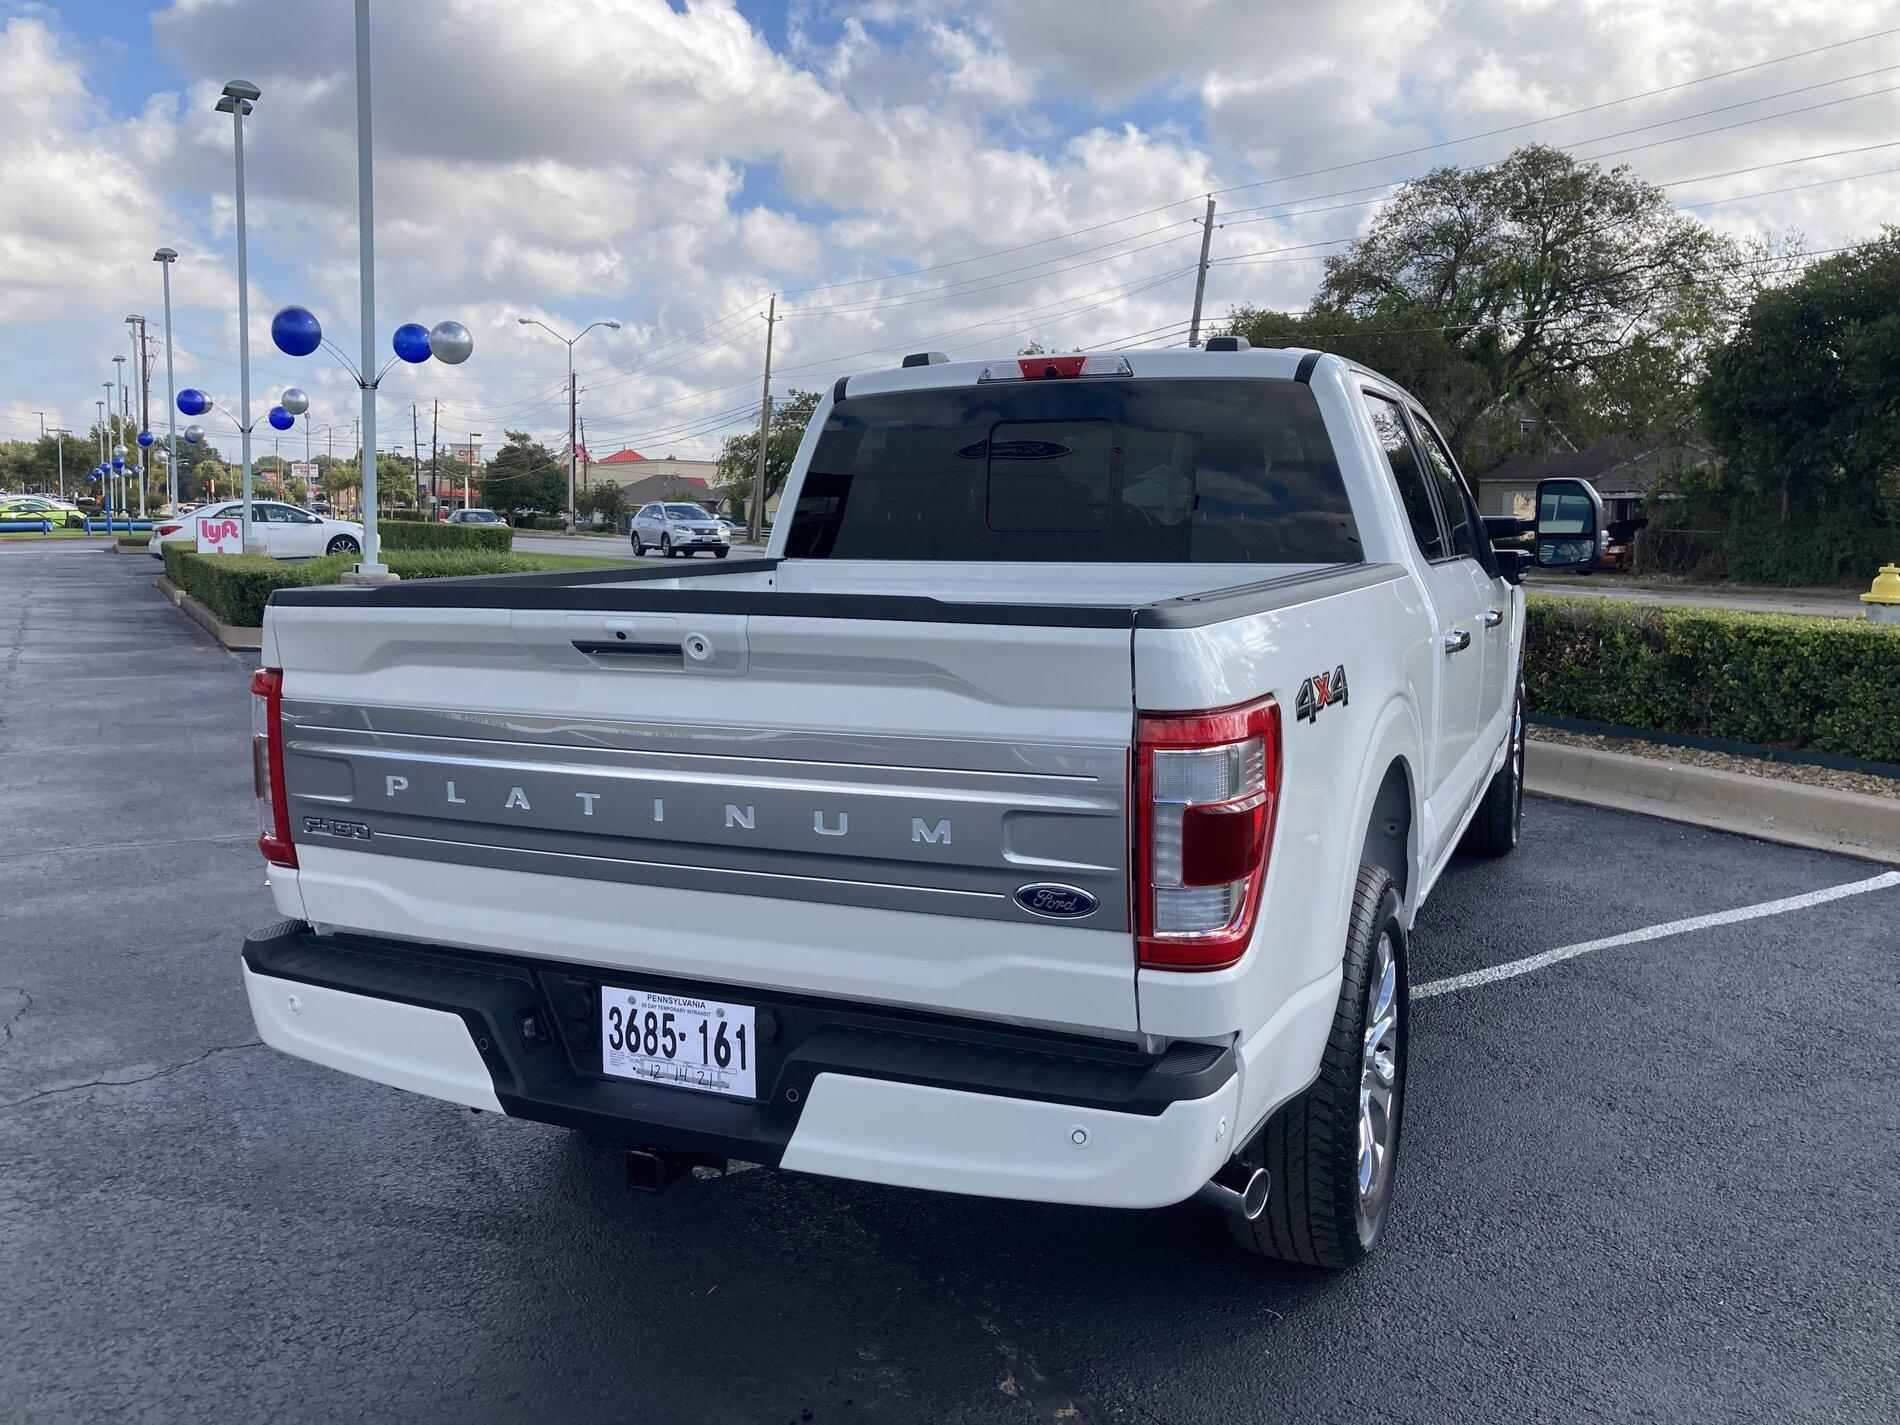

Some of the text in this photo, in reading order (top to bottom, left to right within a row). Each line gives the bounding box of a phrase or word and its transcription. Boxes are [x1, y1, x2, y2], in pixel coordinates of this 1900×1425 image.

[201, 520, 239, 544] lyft
[384, 774, 952, 845] PLATINUM
[1032, 889, 1078, 912] Ford
[647, 994, 707, 1010] PENNSYLVANIA
[658, 1004, 686, 1014] TEMPORARY
